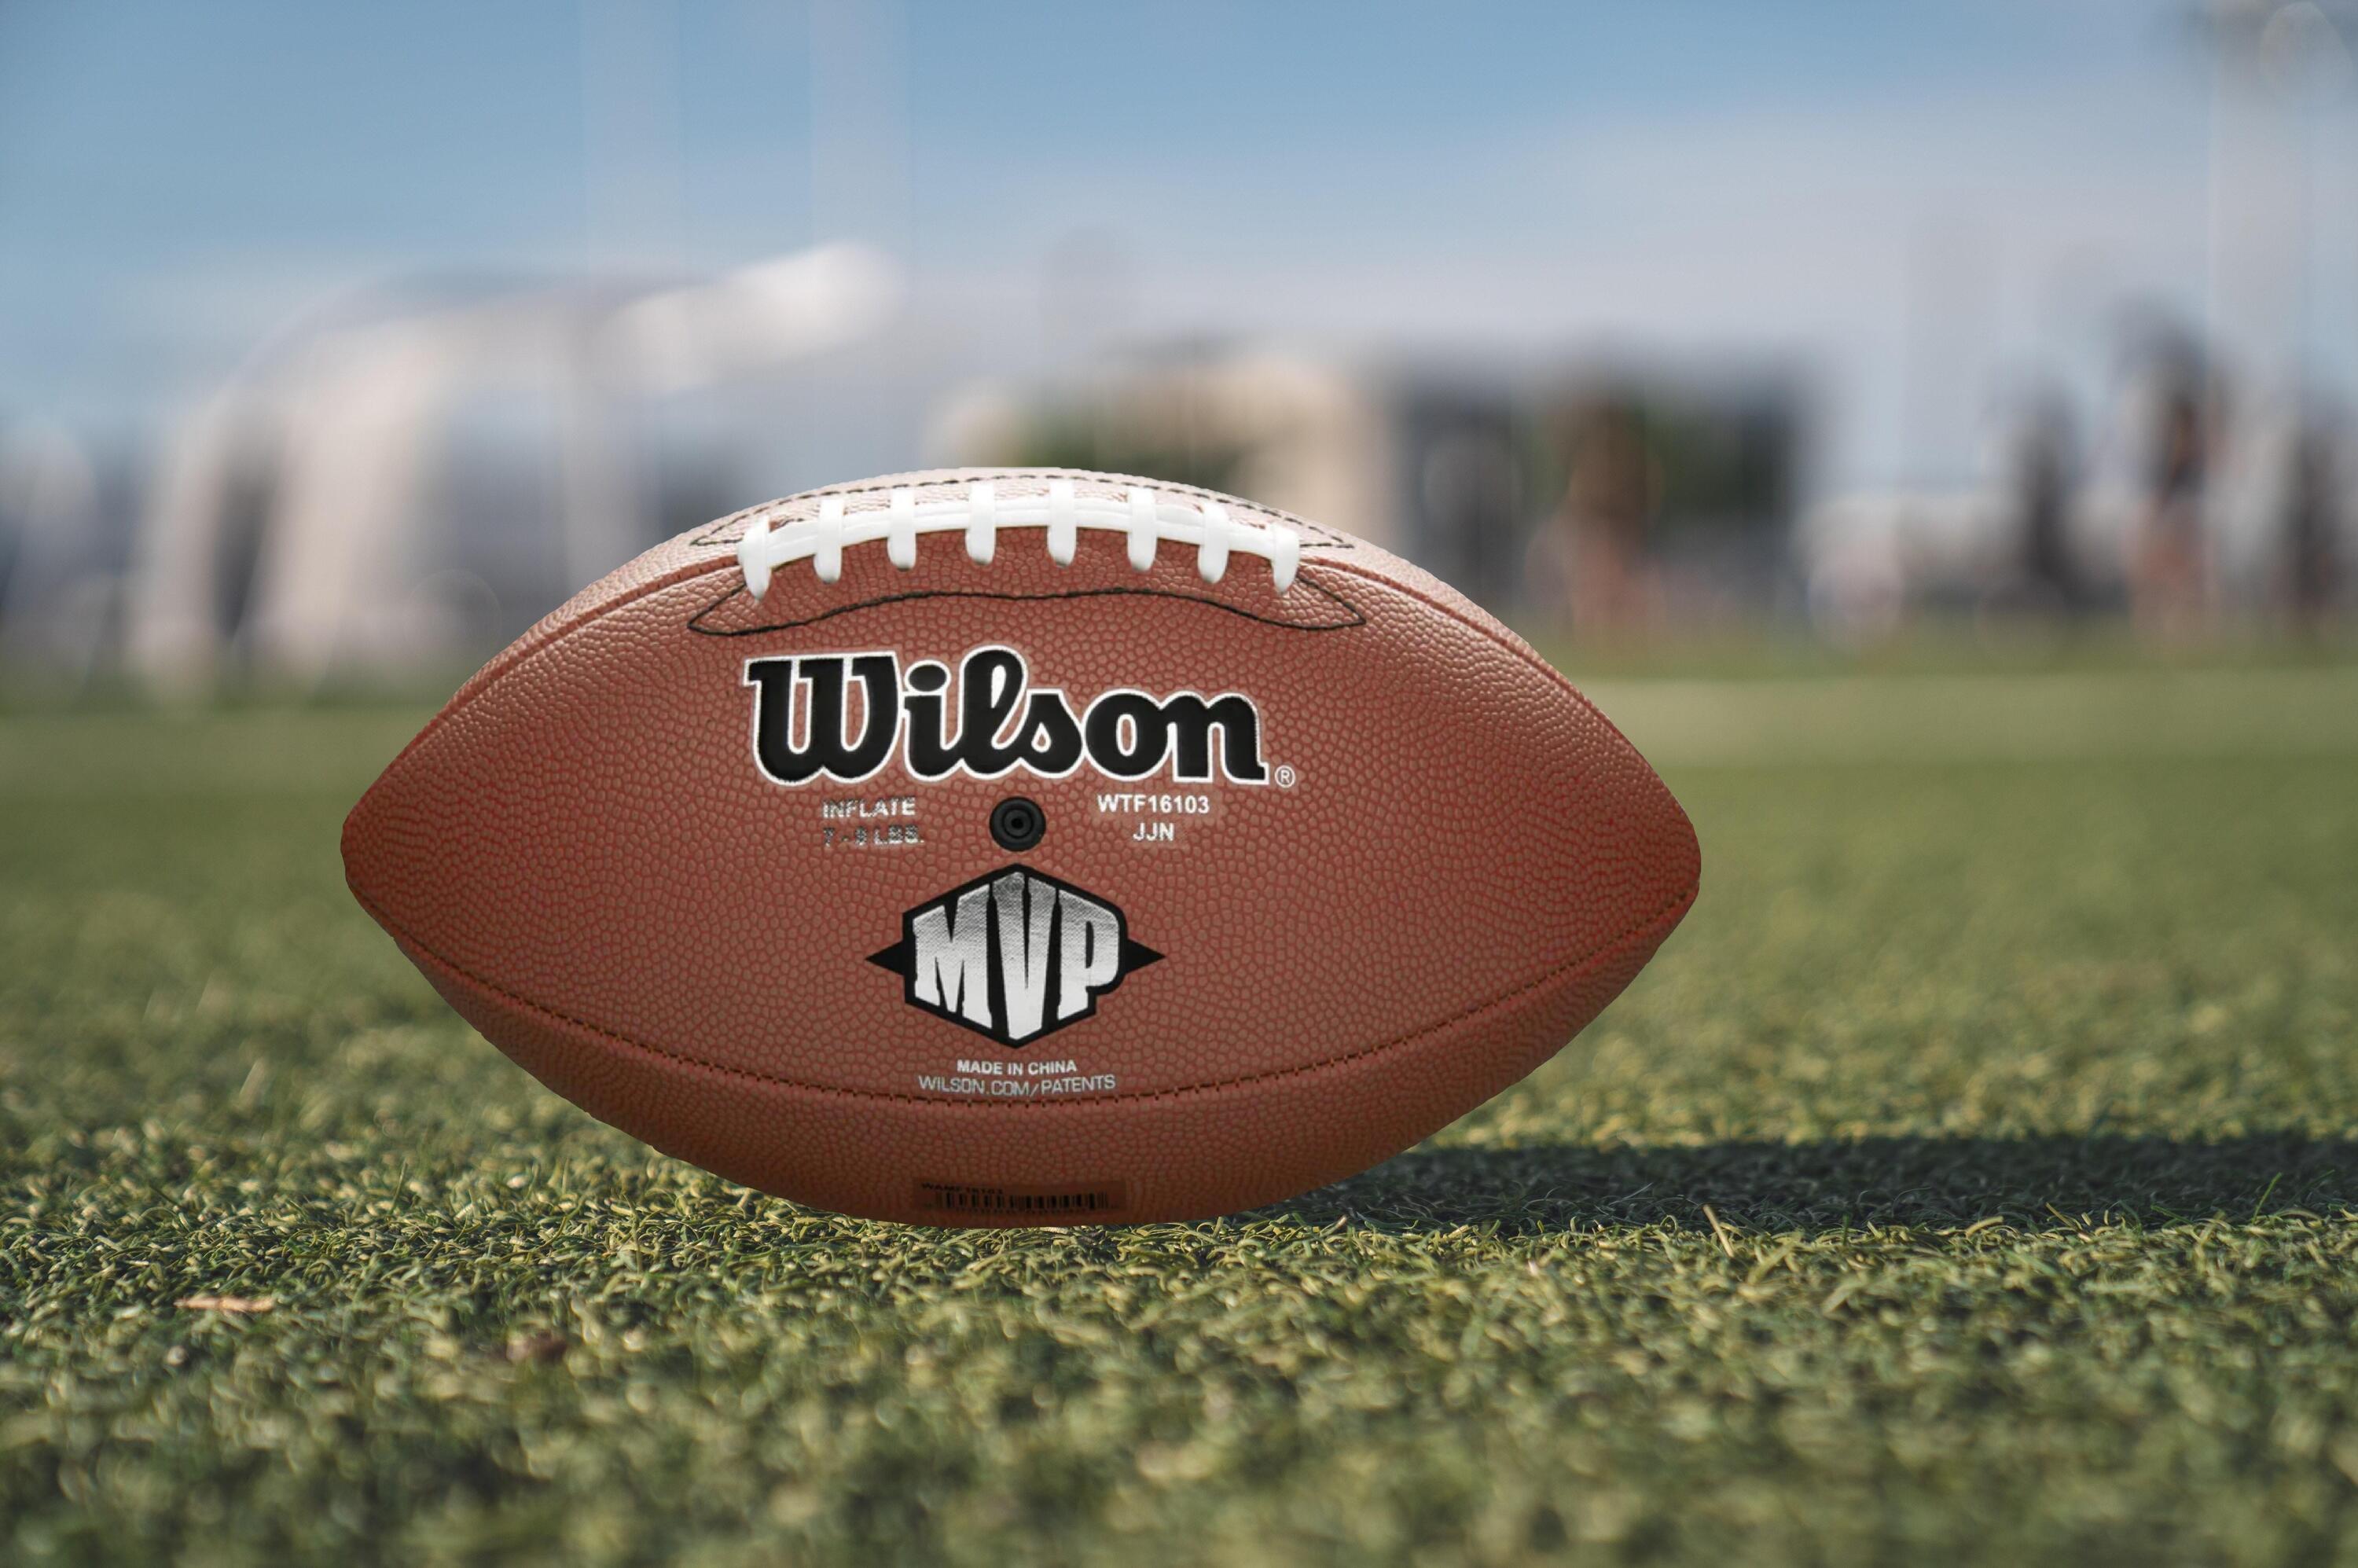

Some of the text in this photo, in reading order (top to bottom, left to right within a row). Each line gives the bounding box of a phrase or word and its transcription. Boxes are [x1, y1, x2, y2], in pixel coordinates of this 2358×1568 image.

[744, 645, 1269, 785] Wilson
[822, 797, 916, 818] INFLATE
[1097, 794, 1210, 814] WTF16103
[1133, 822, 1174, 842] JJN
[912, 871, 1120, 1041] MVP
[957, 1059, 1078, 1076] MADE IN CHINA
[918, 1074, 1116, 1097] WILSON.COM/PATENTS
